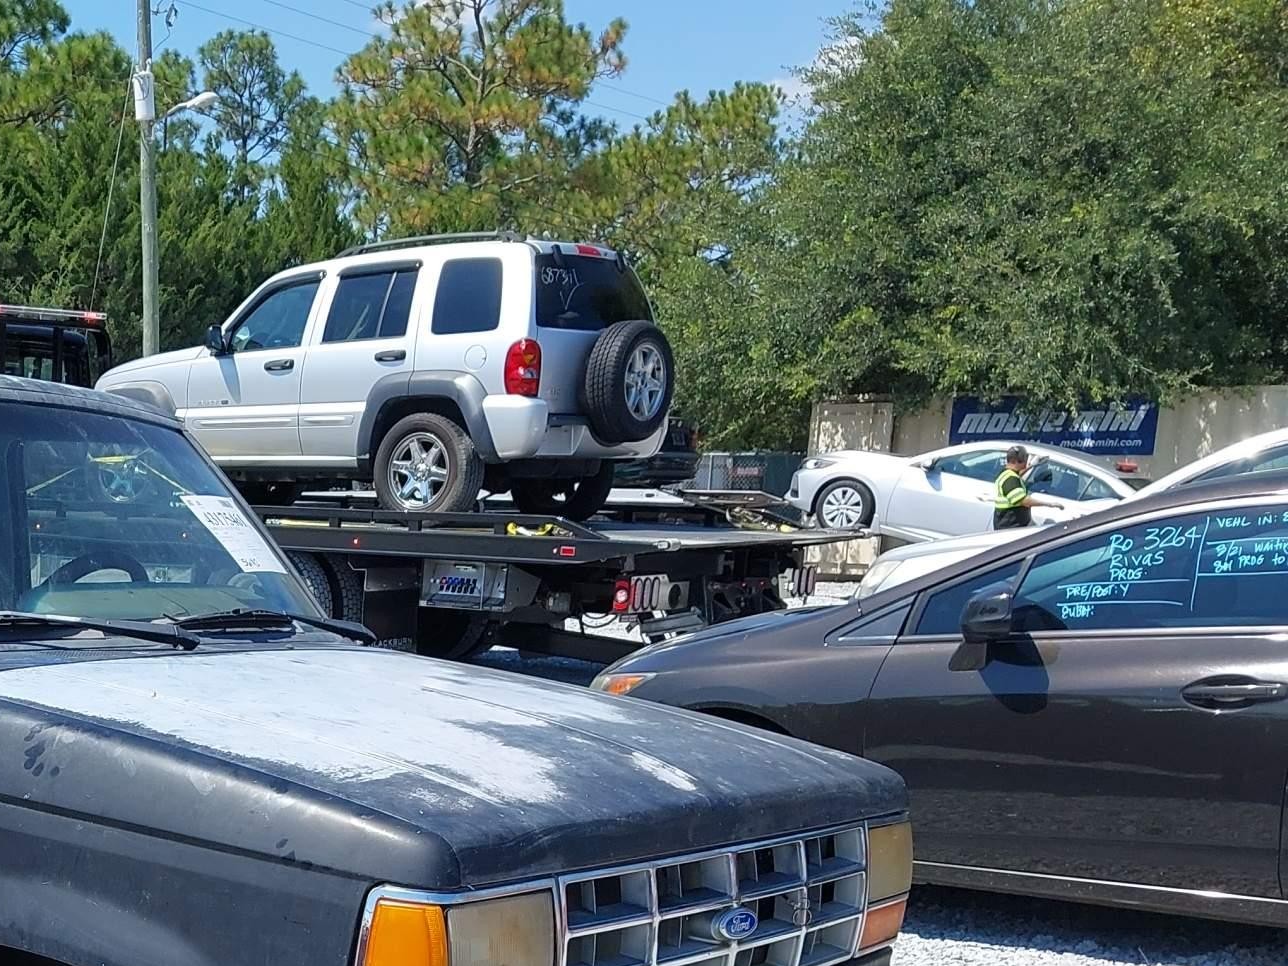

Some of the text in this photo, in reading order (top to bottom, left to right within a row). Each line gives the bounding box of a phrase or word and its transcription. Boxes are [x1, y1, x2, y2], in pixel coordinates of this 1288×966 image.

[1060, 437, 1143, 449] mobilemini.com
[1143, 526, 1202, 551] 3264
[730, 914, 751, 933] Ford
